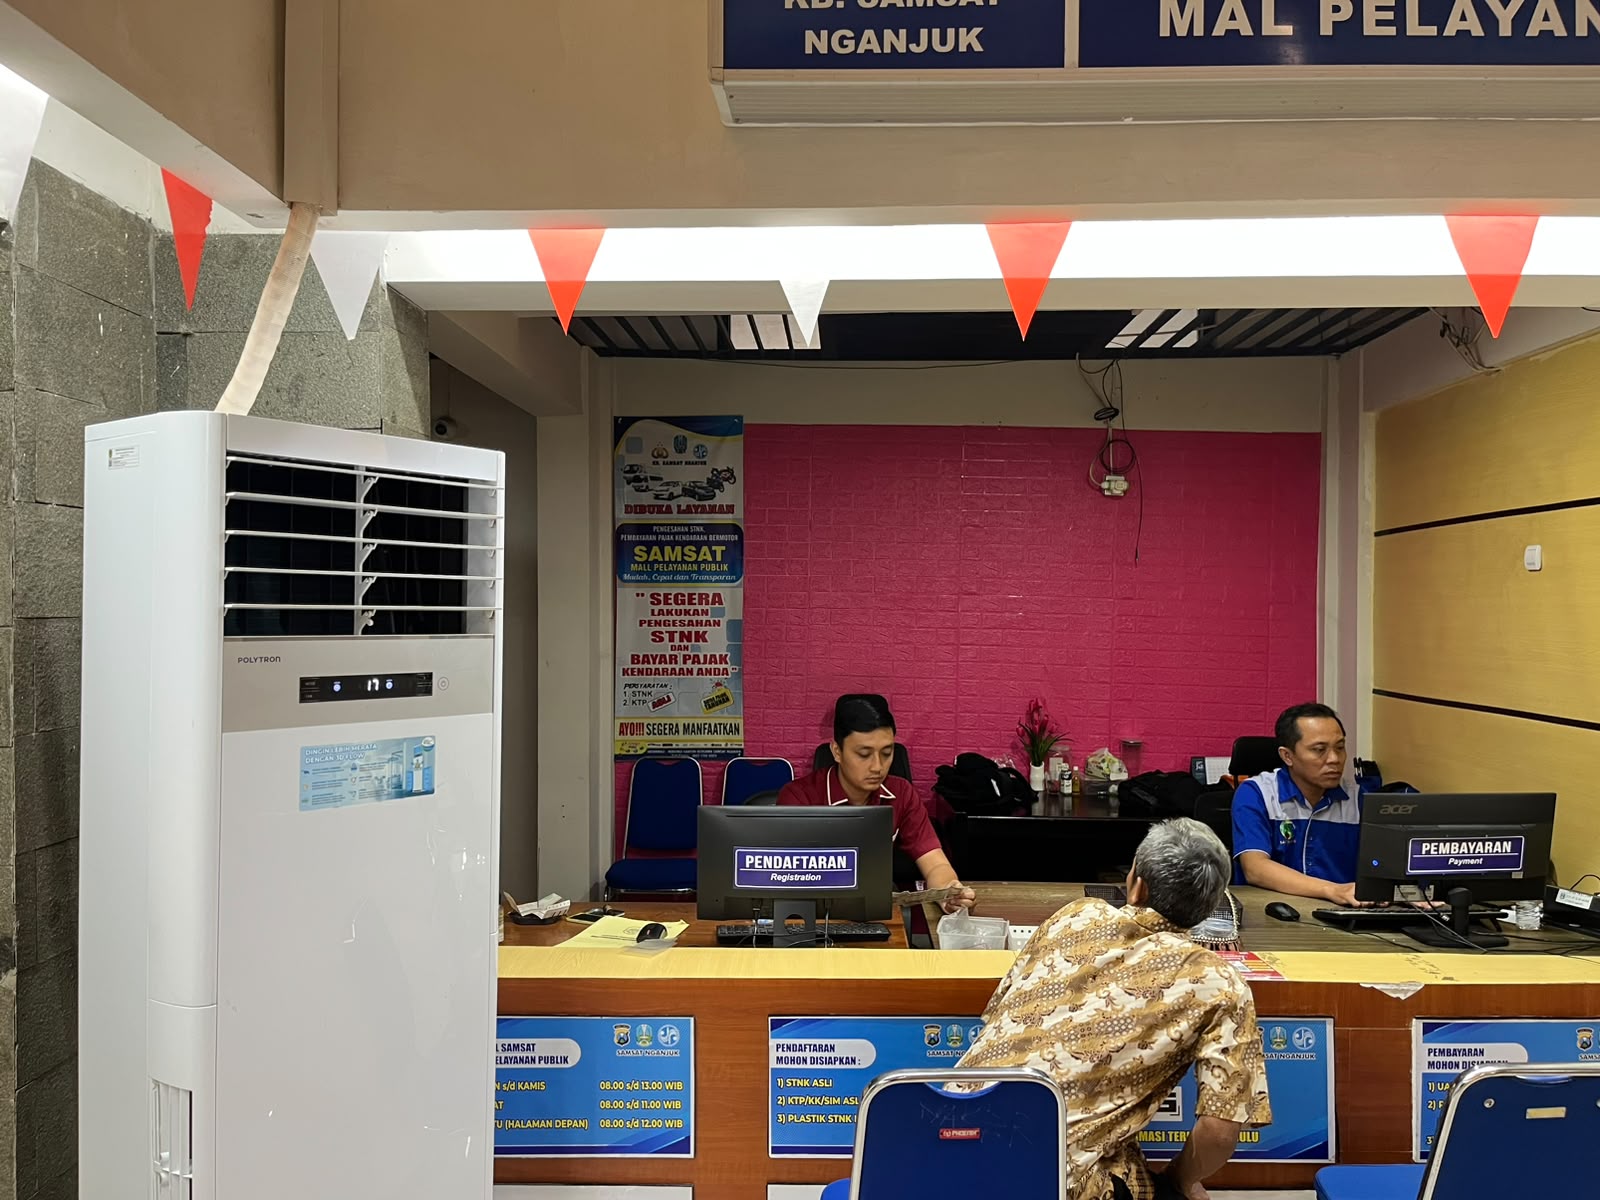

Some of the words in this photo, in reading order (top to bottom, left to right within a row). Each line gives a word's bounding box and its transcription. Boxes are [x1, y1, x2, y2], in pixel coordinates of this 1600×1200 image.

[1159, 0, 1294, 36] MAL
[804, 27, 984, 54] NGANJUK
[624, 504, 673, 514] DIBUKA
[677, 504, 734, 514] LAYANAN
[634, 546, 726, 561] SAMSAT
[690, 574, 736, 582] Transparan
[650, 593, 723, 605] SEGERA
[651, 631, 708, 643] STNK
[631, 654, 678, 665] BAYAR
[682, 654, 728, 665] PAJAK
[622, 668, 693, 676] KENDARAAN
[619, 723, 644, 736] AYO!!!
[646, 723, 679, 736] SEGERA
[683, 723, 739, 736] MANFAATKAN
[1380, 804, 1418, 814] acer
[1422, 841, 1512, 855] PEMBAYARAN
[745, 855, 846, 869] PENDAFTARAN
[1448, 857, 1483, 866] Payment
[771, 873, 822, 882] Registration
[501, 1043, 536, 1052] SAMSAT
[776, 1044, 835, 1052] PENDAFTARAN
[1428, 1048, 1484, 1057] PEMBAYARAN
[496, 1056, 536, 1064] ELAYANAN
[539, 1056, 569, 1064] PUBLIK
[776, 1056, 809, 1065] MOHON
[810, 1056, 856, 1065] DISIAPKAN
[1428, 1061, 1460, 1070] MOHON
[502, 1081, 516, 1091] s/d
[518, 1082, 546, 1090] KAMIS
[600, 1081, 624, 1090] 08.00
[626, 1080, 639, 1091] s/d
[641, 1081, 662, 1090] 13.00
[665, 1081, 683, 1090] WIB
[777, 1078, 783, 1088] 1)
[786, 1079, 810, 1087] STNK
[812, 1079, 832, 1087] ASLI
[1428, 1083, 1435, 1092] 1)
[600, 1100, 624, 1109] 08.00
[626, 1099, 639, 1110] s/d
[641, 1100, 661, 1109] 11.00
[663, 1100, 681, 1109] WIB
[777, 1097, 785, 1106] 2)
[788, 1096, 840, 1106] KTP/KK/SIM
[1428, 1100, 1436, 1110] 2)
[505, 1119, 552, 1129] (HALAMAN
[555, 1119, 588, 1129] DEPAN)
[600, 1119, 624, 1128] 08.00
[626, 1118, 639, 1128] s/d
[641, 1119, 662, 1128] 12.00
[665, 1119, 683, 1128] WIB
[777, 1114, 785, 1124] 3)
[788, 1114, 826, 1122] PLASTIK
[828, 1114, 852, 1122] STNK
[1240, 1131, 1259, 1142] ULU
